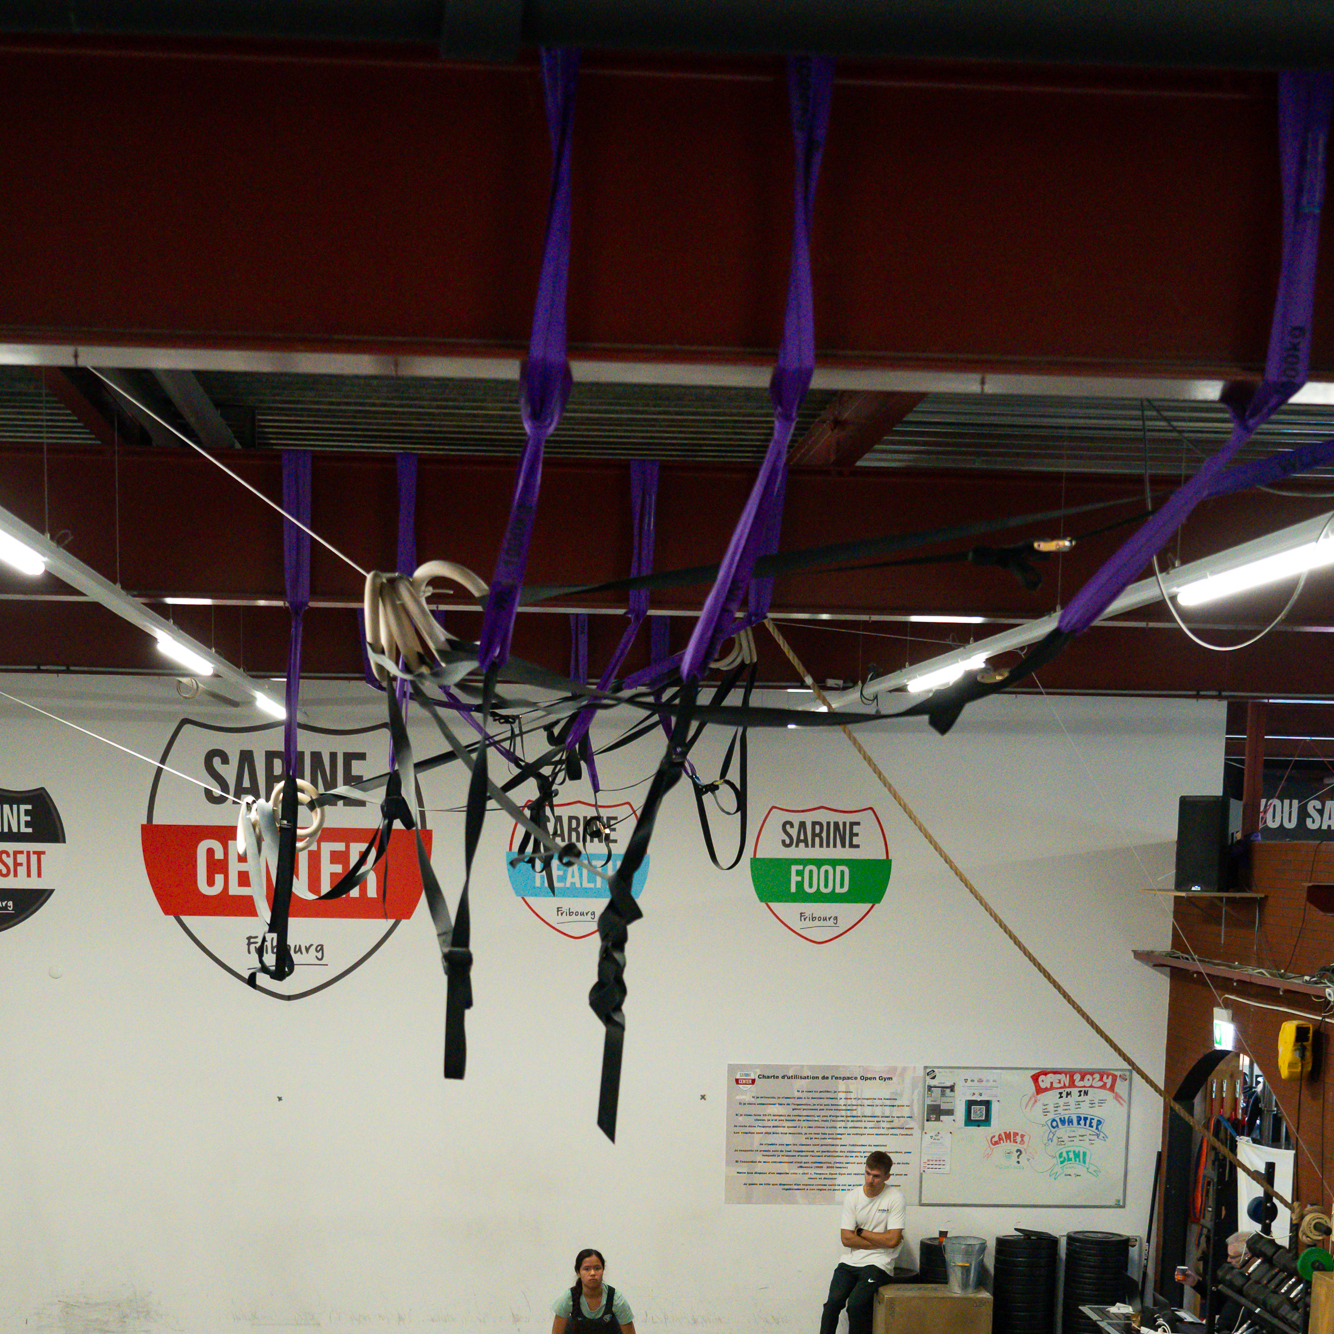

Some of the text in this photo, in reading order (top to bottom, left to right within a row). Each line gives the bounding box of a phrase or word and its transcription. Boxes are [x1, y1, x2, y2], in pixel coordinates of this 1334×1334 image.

[204, 748, 367, 807] SARINE
[541, 814, 619, 843] ARINE
[781, 820, 861, 849] SARINE
[196, 839, 378, 897] CETER
[534, 858, 622, 888] HEALT
[790, 865, 850, 893] FOOD
[556, 906, 596, 920] Fribourg
[799, 912, 839, 925] Fribourg
[1038, 1073, 1113, 1089] OPEN 2024
[1058, 1089, 1089, 1099] I'M IN
[1050, 1116, 1104, 1132] QUARTER
[989, 1131, 1027, 1146] GAMES
[1058, 1150, 1088, 1166] SEMI
